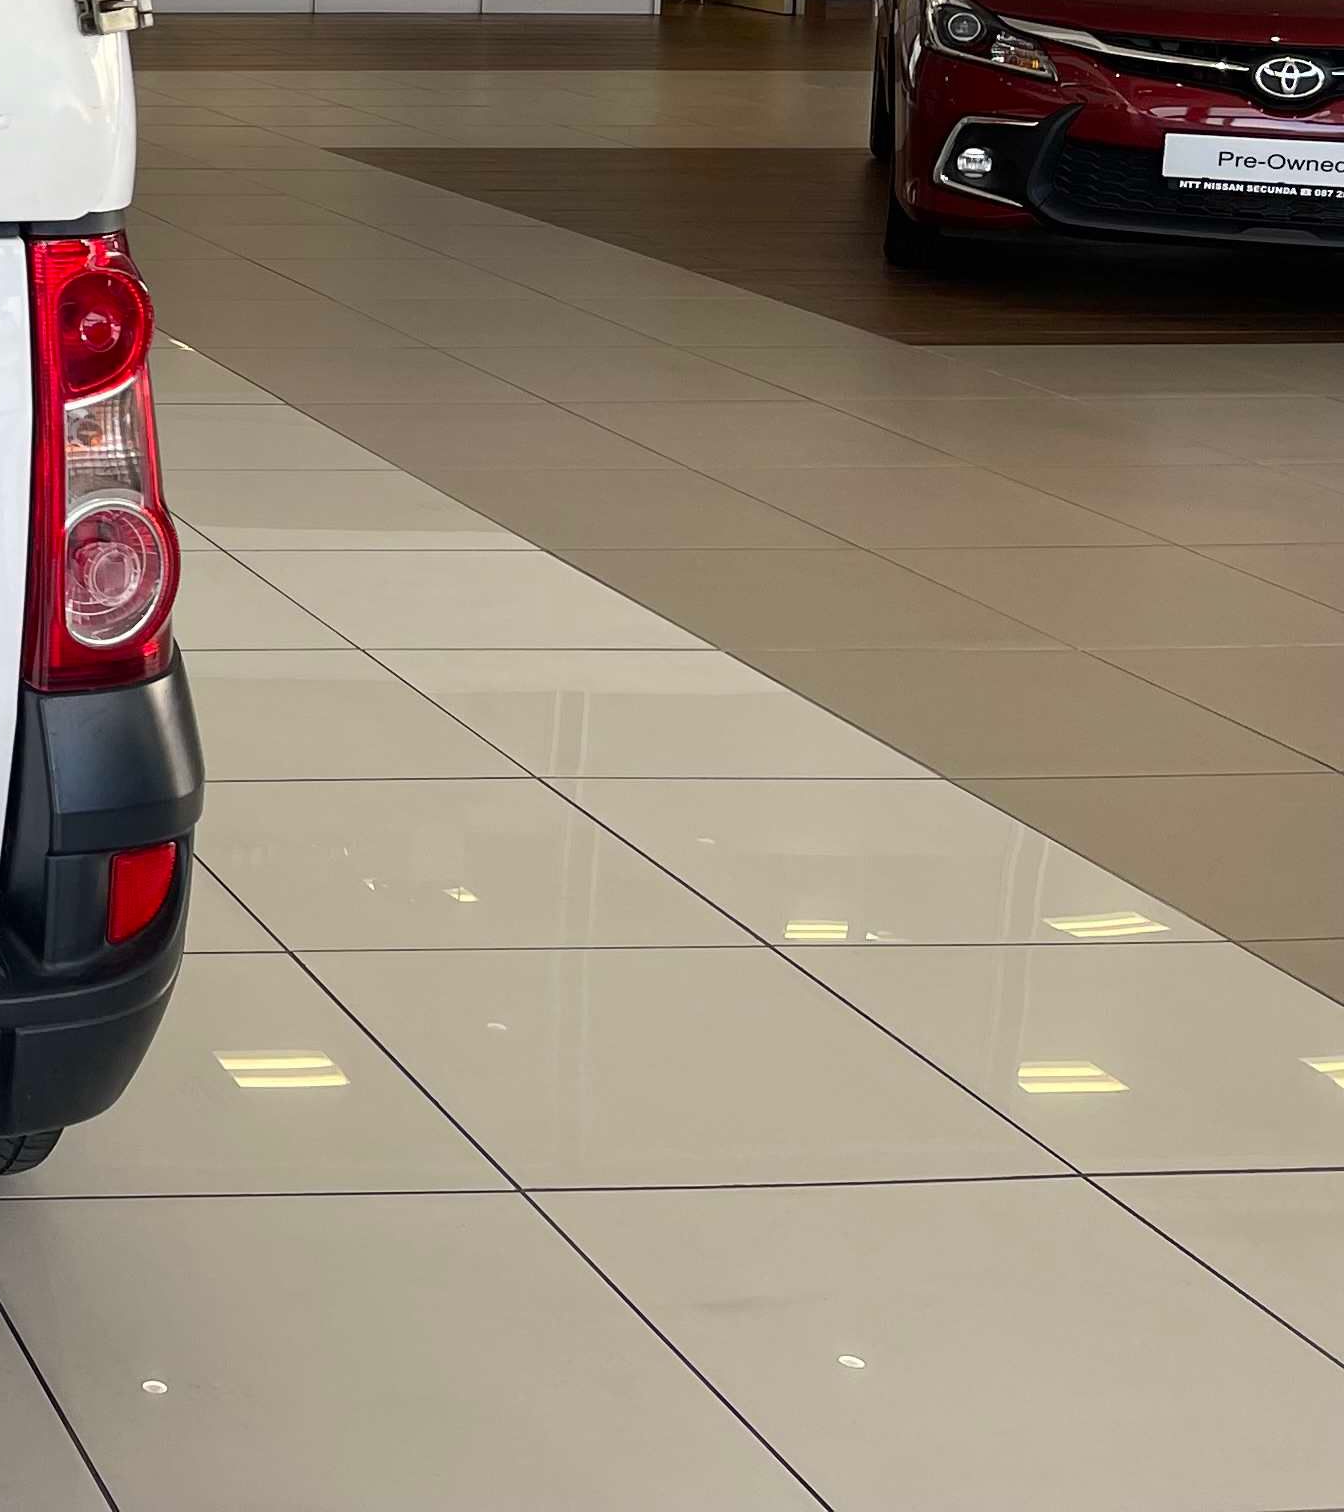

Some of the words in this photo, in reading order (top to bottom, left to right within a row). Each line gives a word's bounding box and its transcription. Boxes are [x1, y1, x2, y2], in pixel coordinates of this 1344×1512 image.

[1179, 180, 1202, 189] NTT
[1203, 181, 1244, 192] NISSAN
[1246, 184, 1297, 195] SECUNDA
